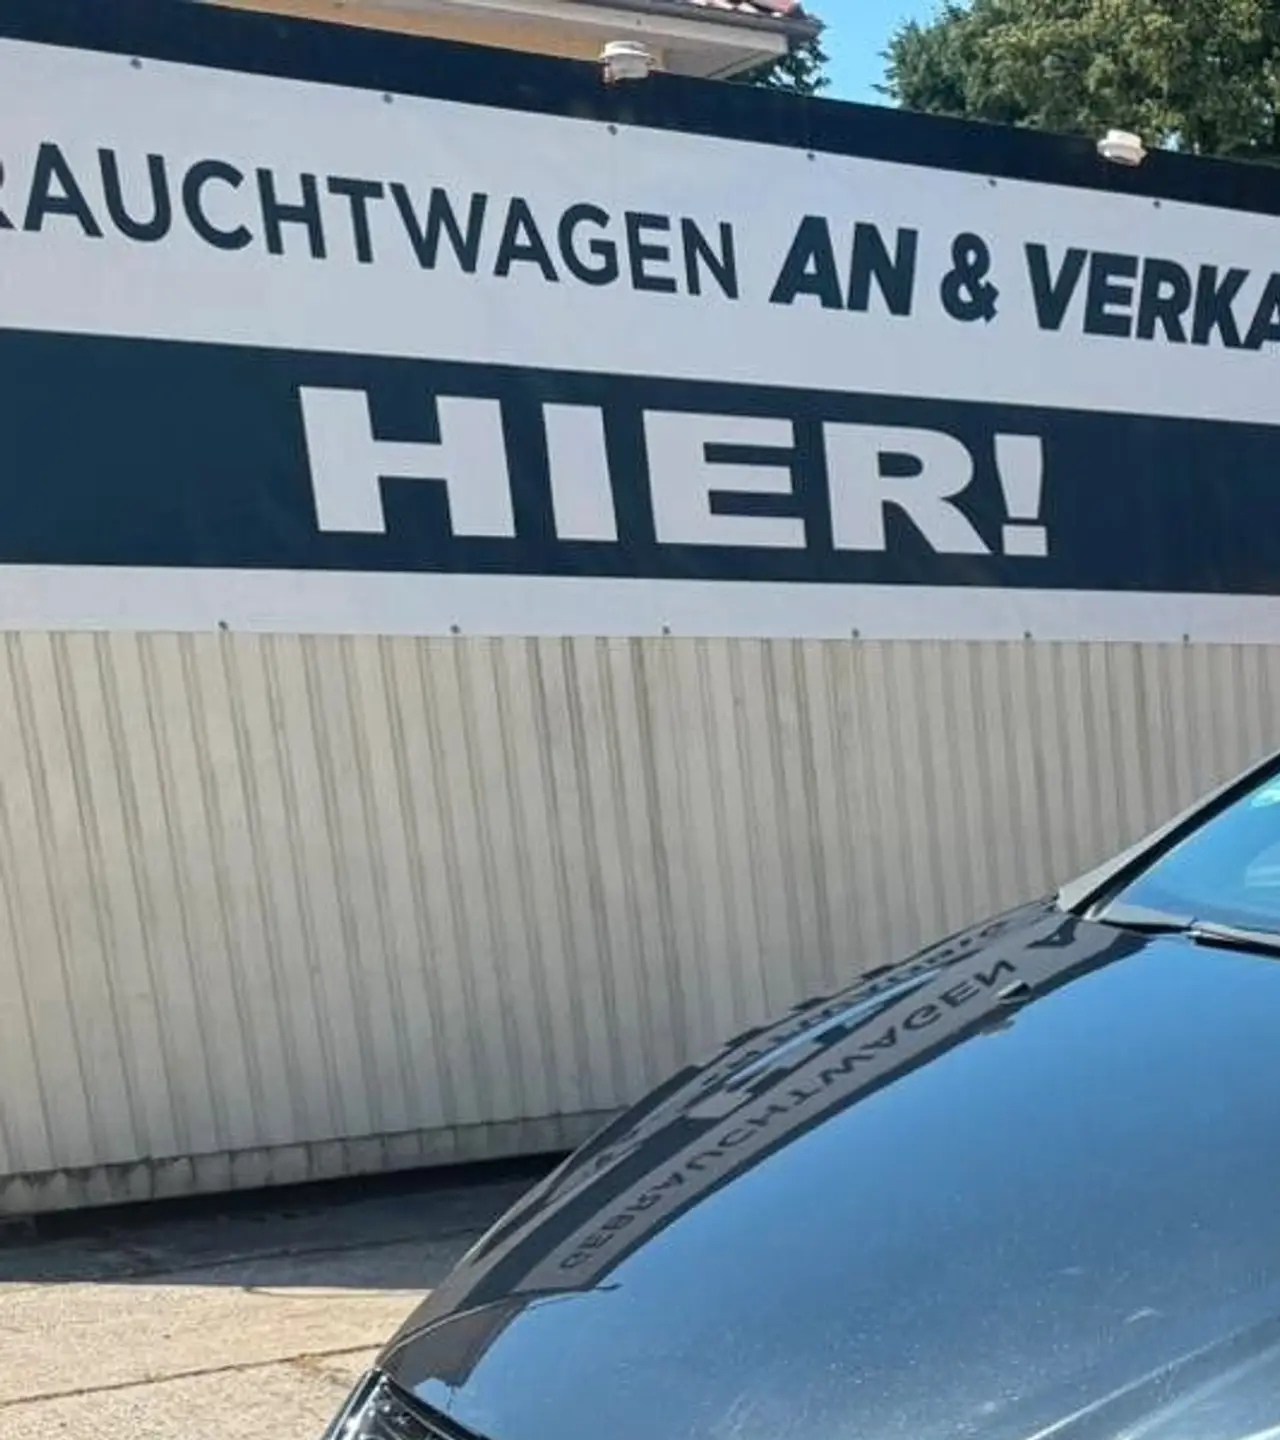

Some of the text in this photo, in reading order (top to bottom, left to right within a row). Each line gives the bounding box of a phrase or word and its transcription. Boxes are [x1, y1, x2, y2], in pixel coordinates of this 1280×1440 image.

[0, 142, 737, 299] AUCHTWAGEN
[771, 216, 917, 315] AN
[941, 232, 999, 324] &
[300, 386, 1049, 558] HIER!
